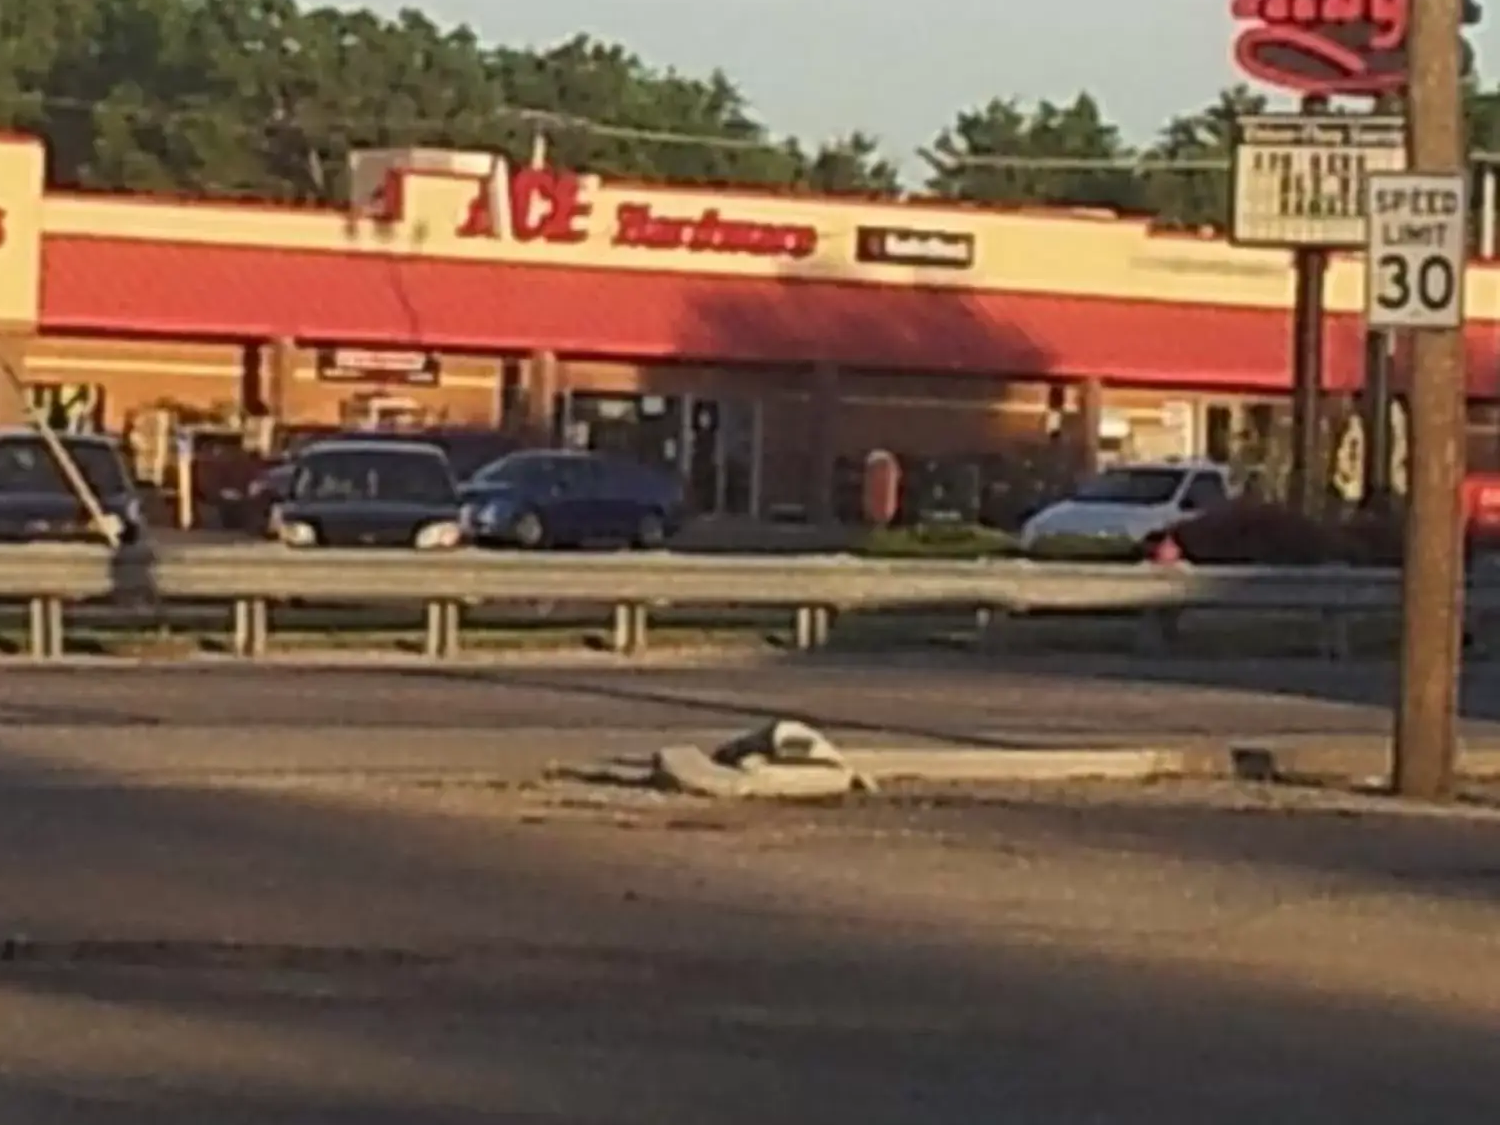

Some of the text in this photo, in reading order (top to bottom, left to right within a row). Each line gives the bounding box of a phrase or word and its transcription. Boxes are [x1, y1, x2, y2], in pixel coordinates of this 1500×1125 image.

[1375, 187, 1458, 215] SPEED
[1382, 222, 1449, 247] LIMIT
[1376, 253, 1454, 311] 30
